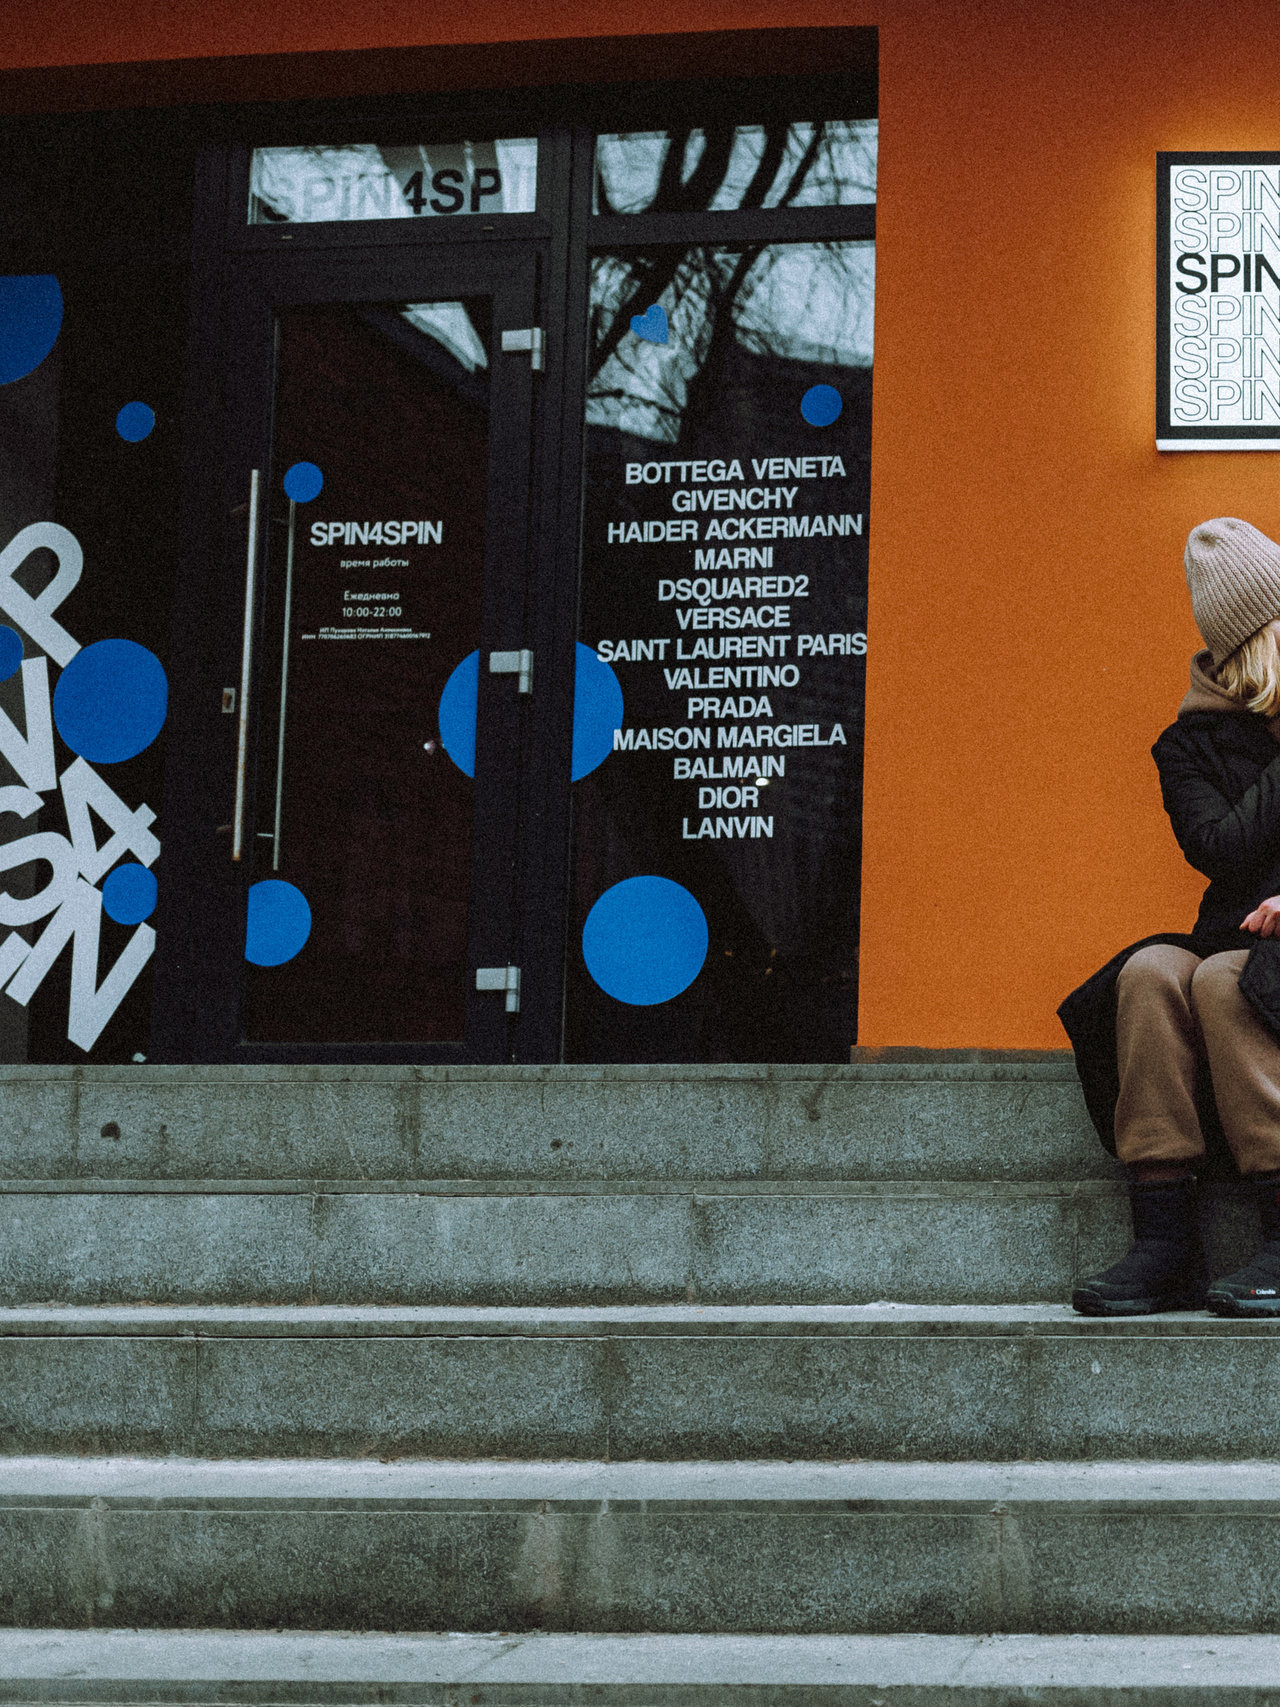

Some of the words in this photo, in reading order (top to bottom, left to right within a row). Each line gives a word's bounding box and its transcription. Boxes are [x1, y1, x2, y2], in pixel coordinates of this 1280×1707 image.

[625, 459, 744, 484] BOTTEGA
[751, 455, 846, 479] VENETA
[672, 486, 799, 512] GIVENCHY
[309, 520, 443, 546] SPIN4SPIN
[607, 519, 698, 543] HAIDER
[704, 513, 863, 540] ACKERMANN
[340, 559, 371, 569] время
[372, 557, 409, 569] работы
[694, 546, 774, 570] MARNI
[343, 590, 400, 601] Ежедневно
[658, 574, 809, 606] DSQUARED2
[342, 606, 402, 617] 10:00-22:00
[675, 605, 791, 630] VERSACE
[596, 638, 671, 663] SAINT
[676, 635, 791, 660] LAURENT
[797, 632, 867, 656] PARIS
[663, 664, 800, 690] VALENTINO
[687, 695, 773, 719] PRADA
[613, 727, 711, 751] MAISON
[717, 723, 847, 748] MARGIELA
[673, 755, 786, 780] BALMAIN
[698, 786, 760, 809] DIOR
[682, 815, 774, 840] LANVIN
